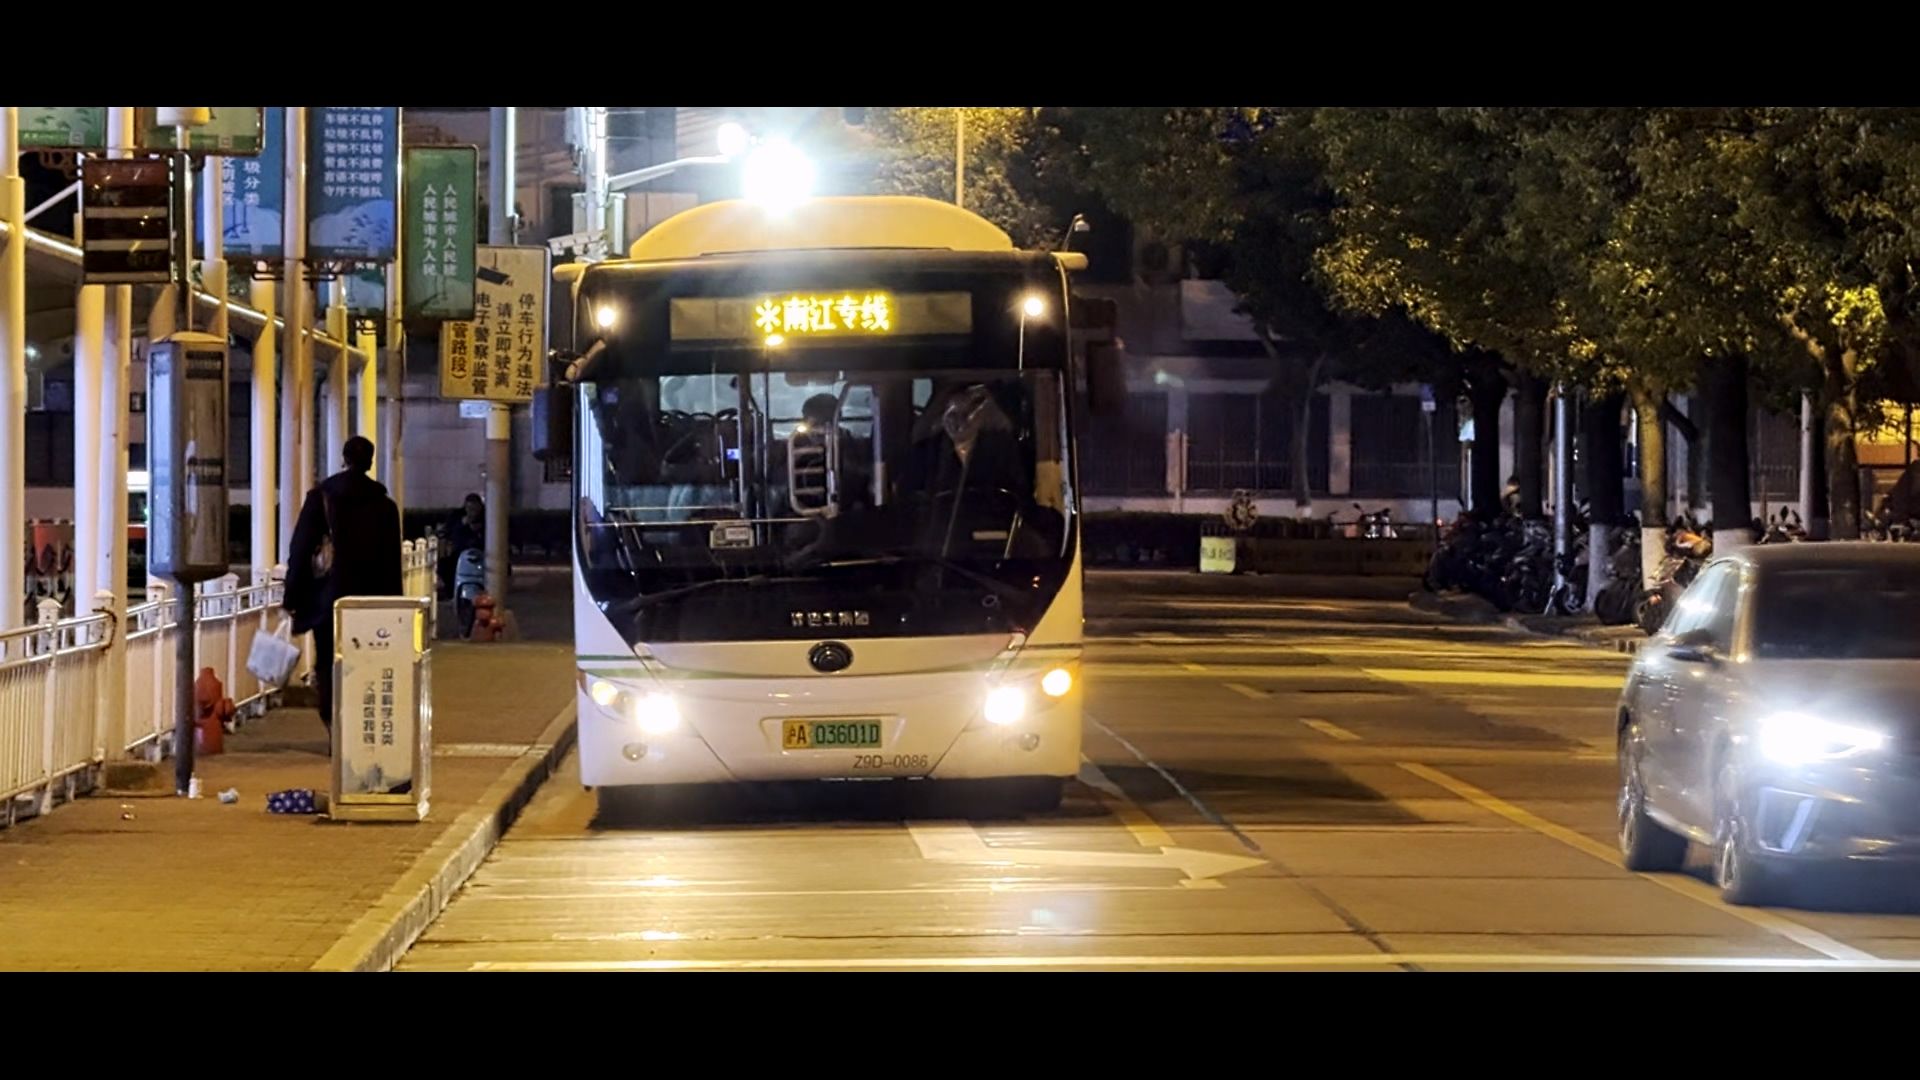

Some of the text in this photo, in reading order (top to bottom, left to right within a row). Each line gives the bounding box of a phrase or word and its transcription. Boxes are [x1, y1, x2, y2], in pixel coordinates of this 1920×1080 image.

[423, 184, 438, 276] 人民城市为人民
[471, 292, 492, 395] 电子警察监管
[494, 303, 513, 388] 请立即驶离
[516, 293, 536, 396] 停车行为违法
[782, 295, 890, 333] 南江专线
[815, 725, 880, 744] 03601D
